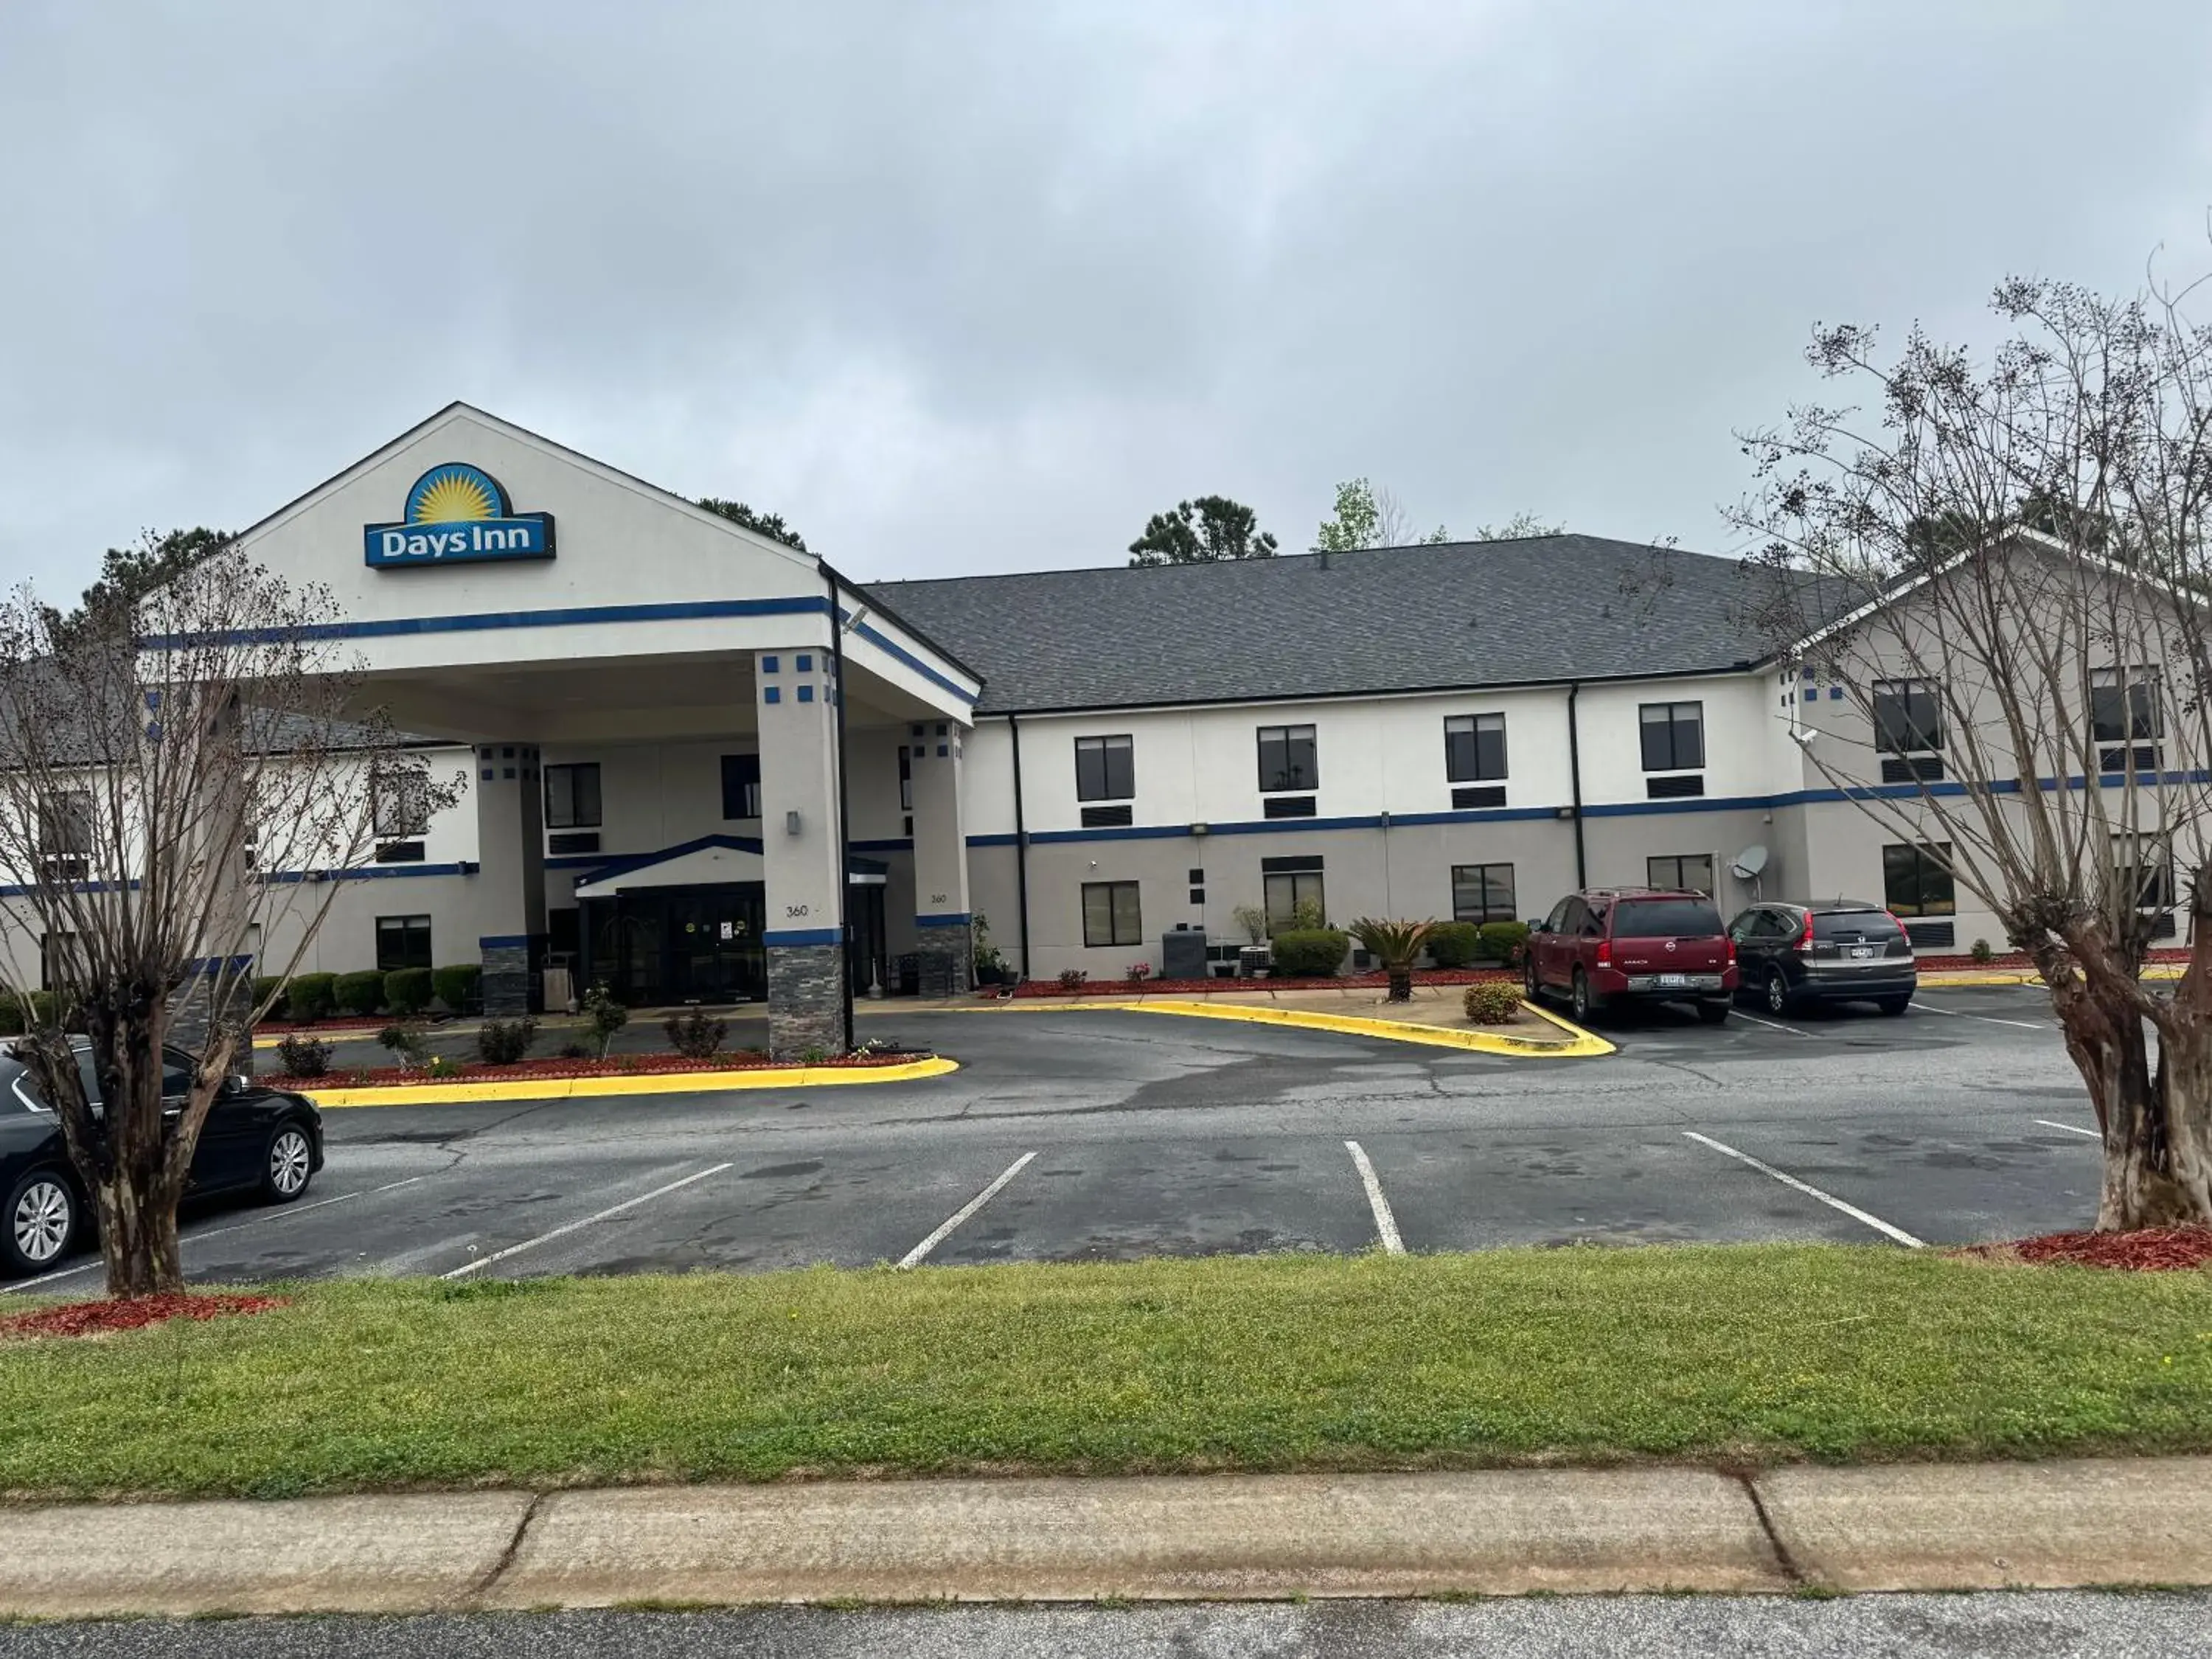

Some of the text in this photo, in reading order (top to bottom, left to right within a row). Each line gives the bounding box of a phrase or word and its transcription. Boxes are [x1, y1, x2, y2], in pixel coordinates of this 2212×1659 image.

[382, 526, 530, 557] Days Inn
[786, 905, 809, 918] 360
